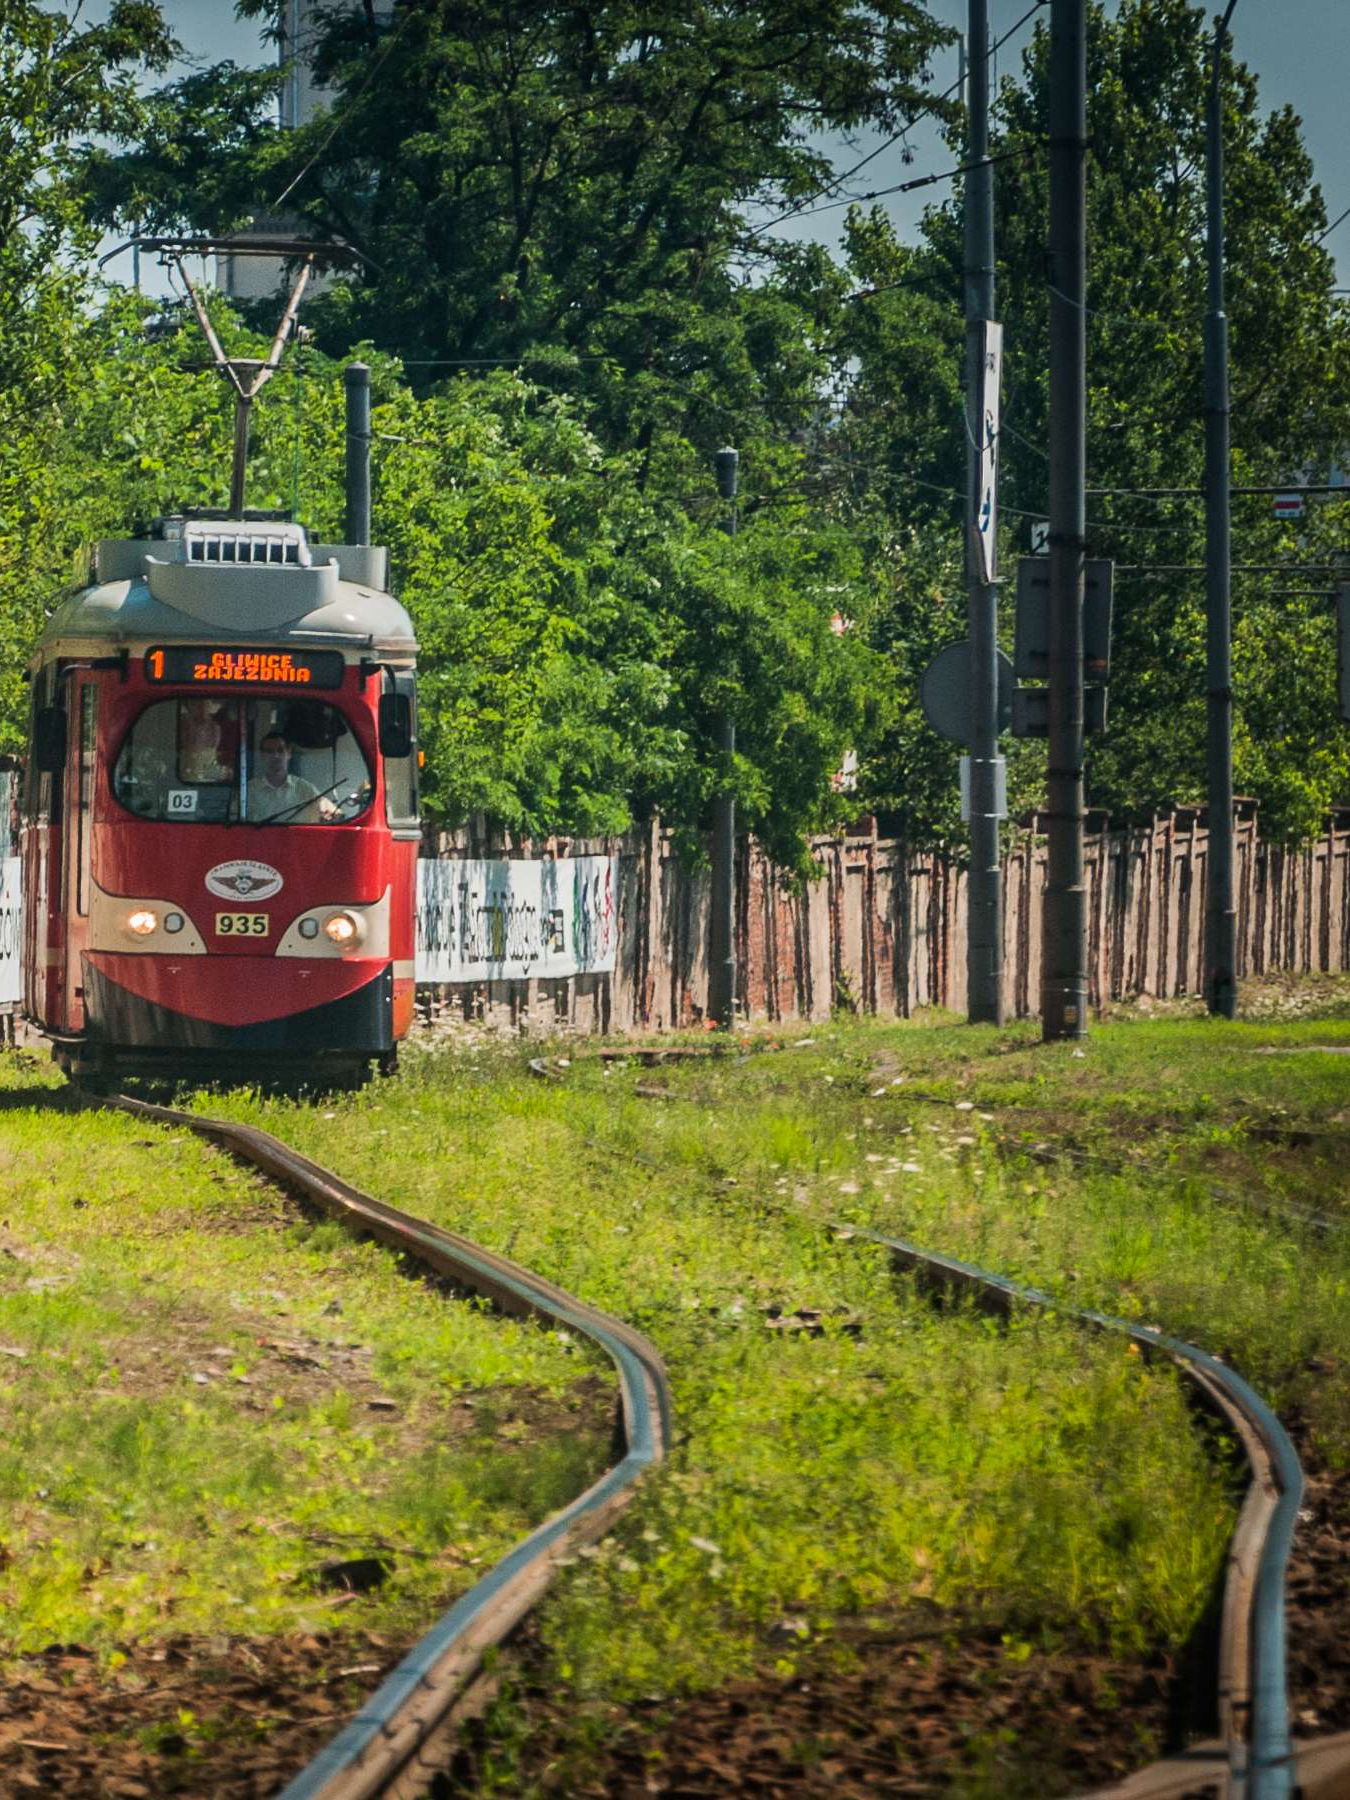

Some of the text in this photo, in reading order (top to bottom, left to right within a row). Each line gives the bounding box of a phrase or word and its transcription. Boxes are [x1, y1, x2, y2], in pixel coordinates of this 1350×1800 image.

[150, 650, 164, 679] 1
[212, 652, 292, 668] GLIWICE
[193, 664, 312, 682] ZAJEZDNIA
[172, 794, 192, 808] 03
[220, 915, 266, 934] 935
